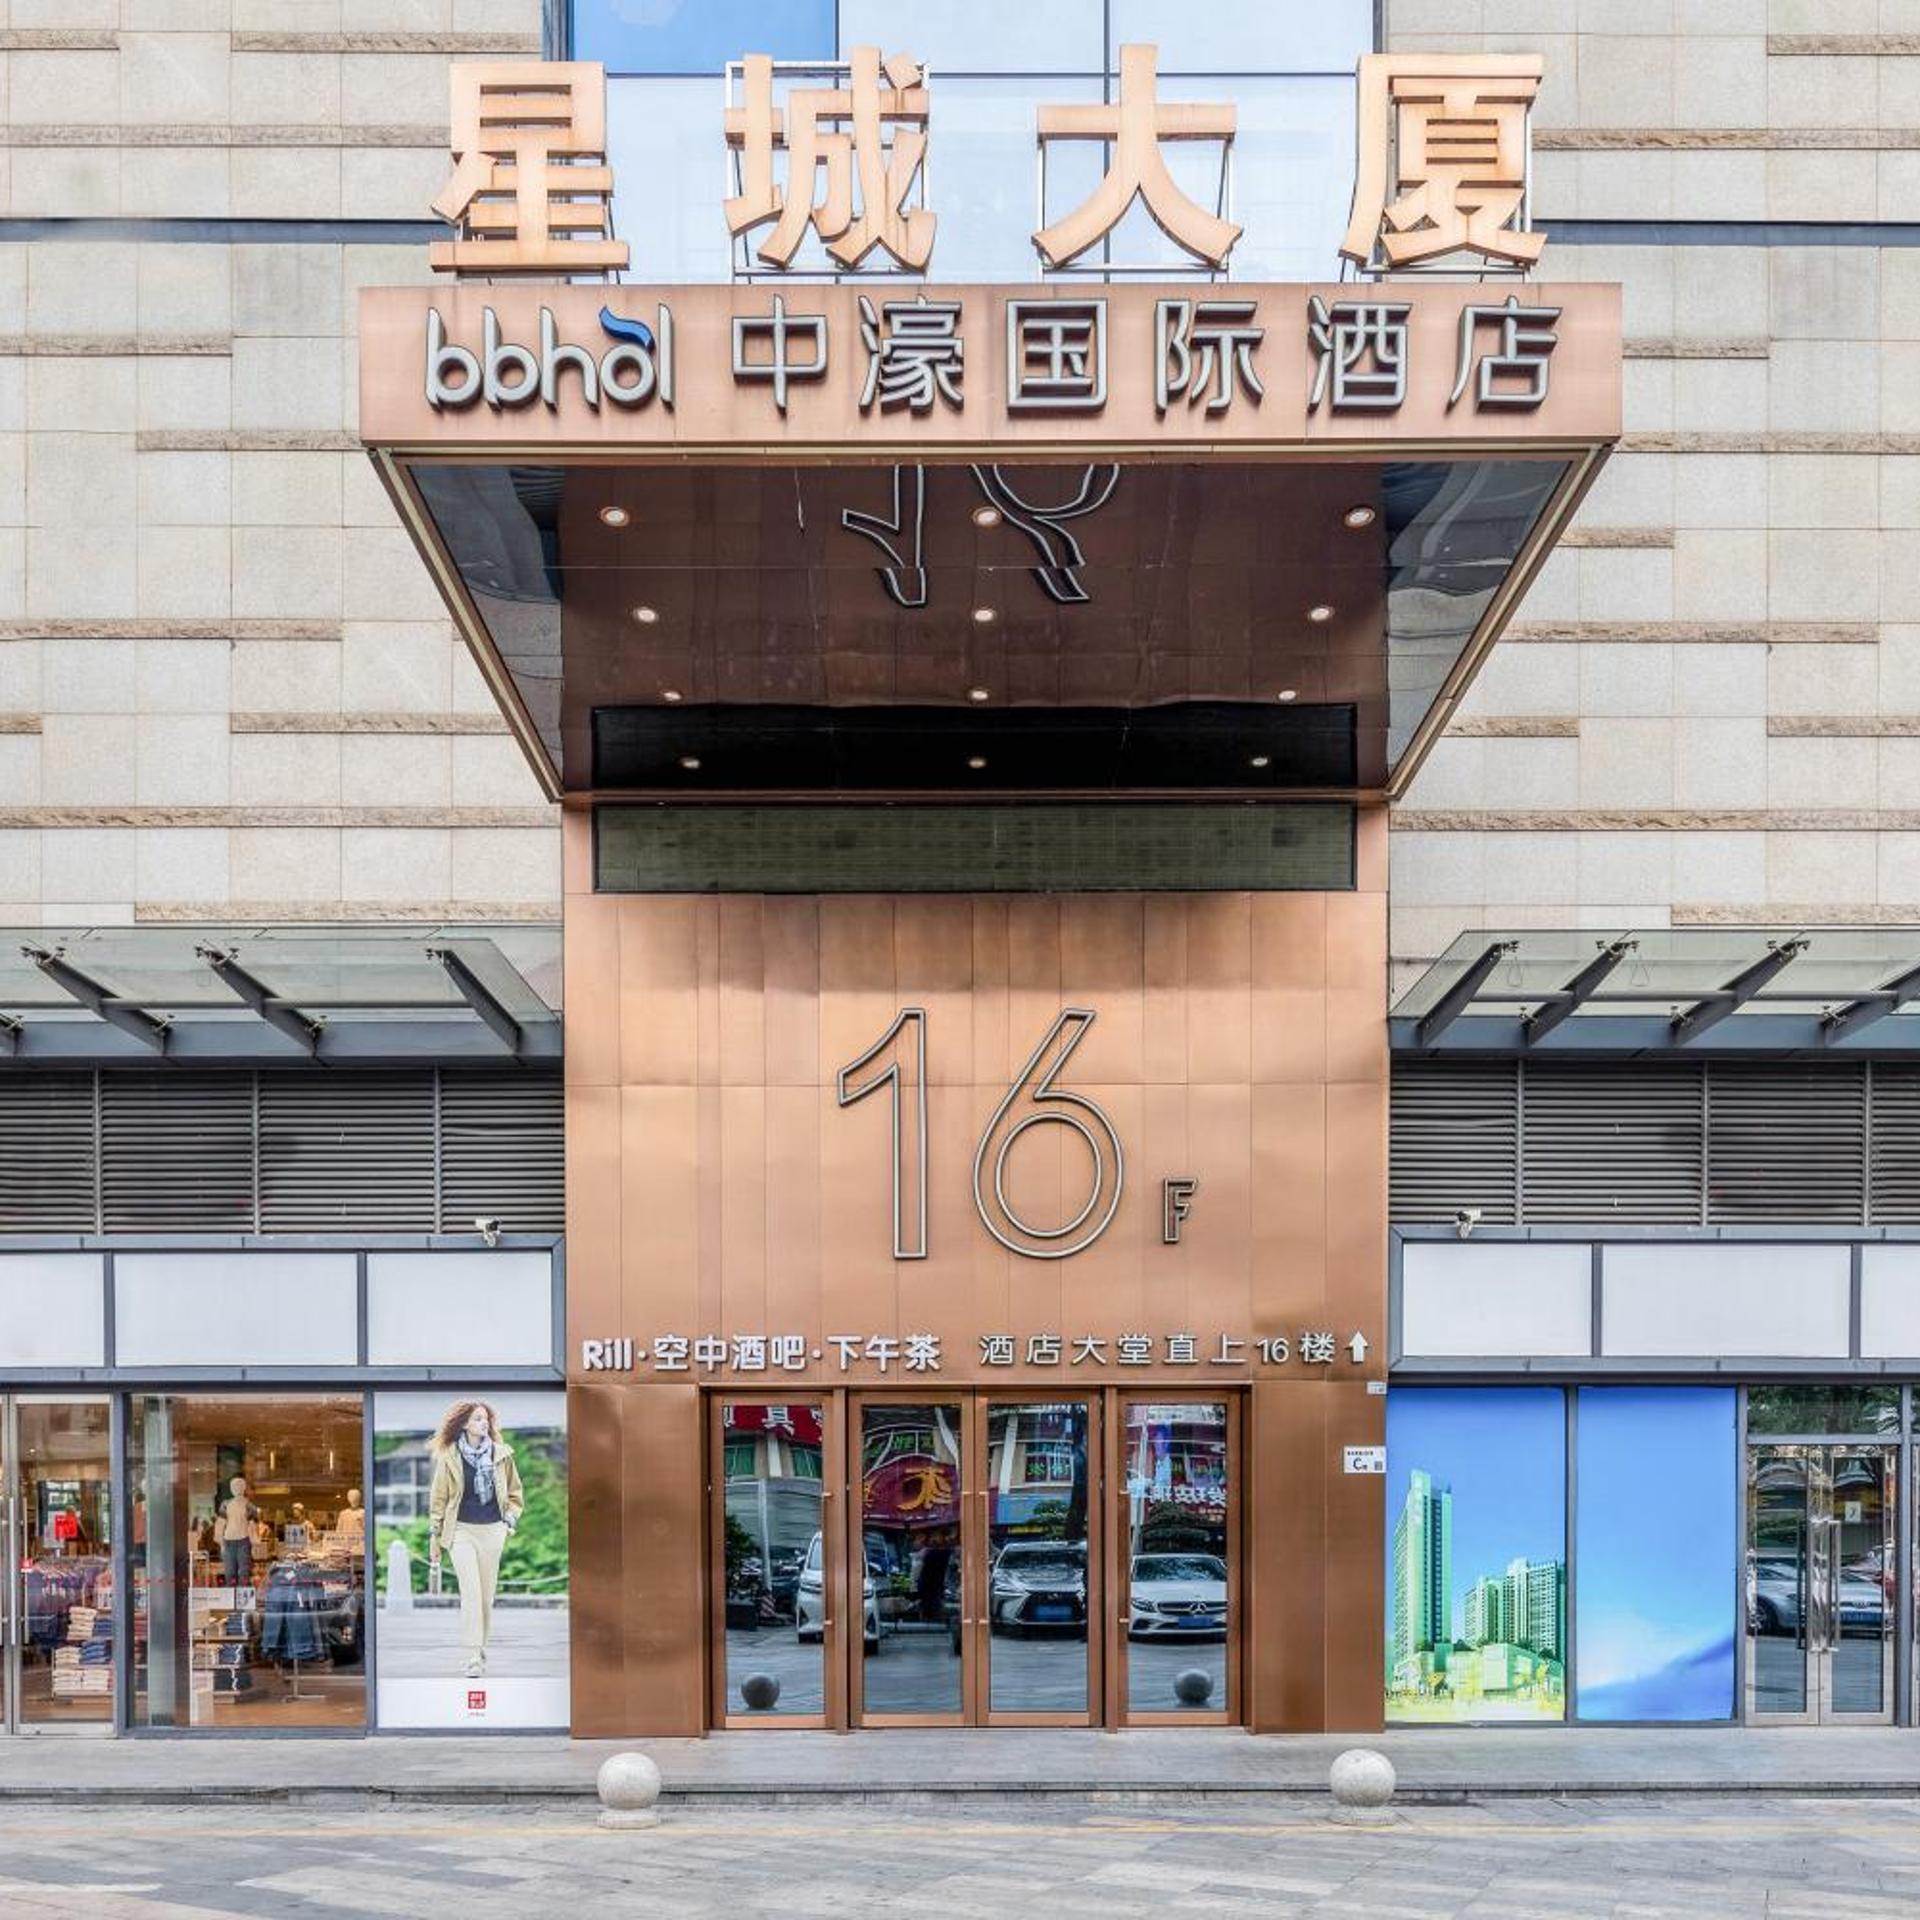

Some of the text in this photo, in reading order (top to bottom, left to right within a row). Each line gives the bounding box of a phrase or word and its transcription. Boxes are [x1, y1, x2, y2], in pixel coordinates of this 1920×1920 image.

[429, 44, 1548, 272] 星城大厦
[732, 295, 1564, 416] 中濠国际酒店
